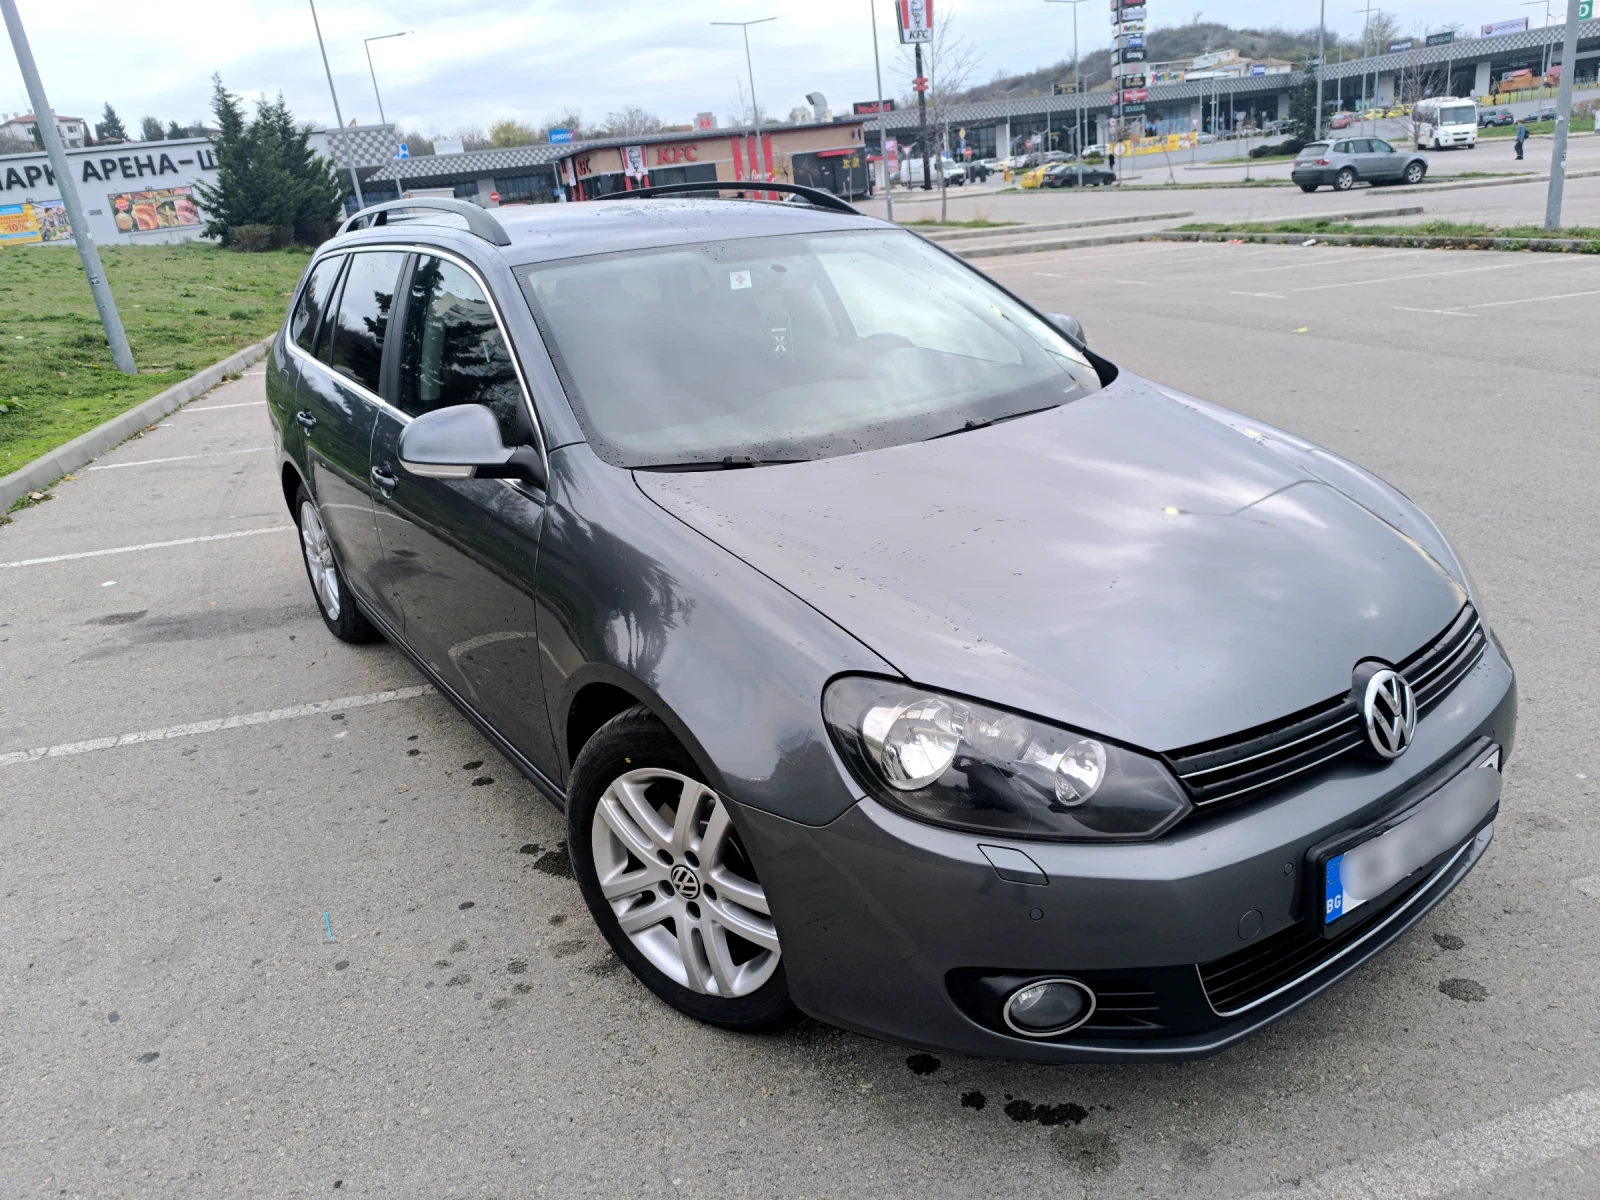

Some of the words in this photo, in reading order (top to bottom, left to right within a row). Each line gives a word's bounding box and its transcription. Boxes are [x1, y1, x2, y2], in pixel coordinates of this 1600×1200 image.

[909, 30, 929, 39] KFC
[656, 144, 699, 166] KFC
[577, 156, 592, 176] KFC
[0, 164, 56, 190] АРК
[1326, 894, 1342, 915] BG
